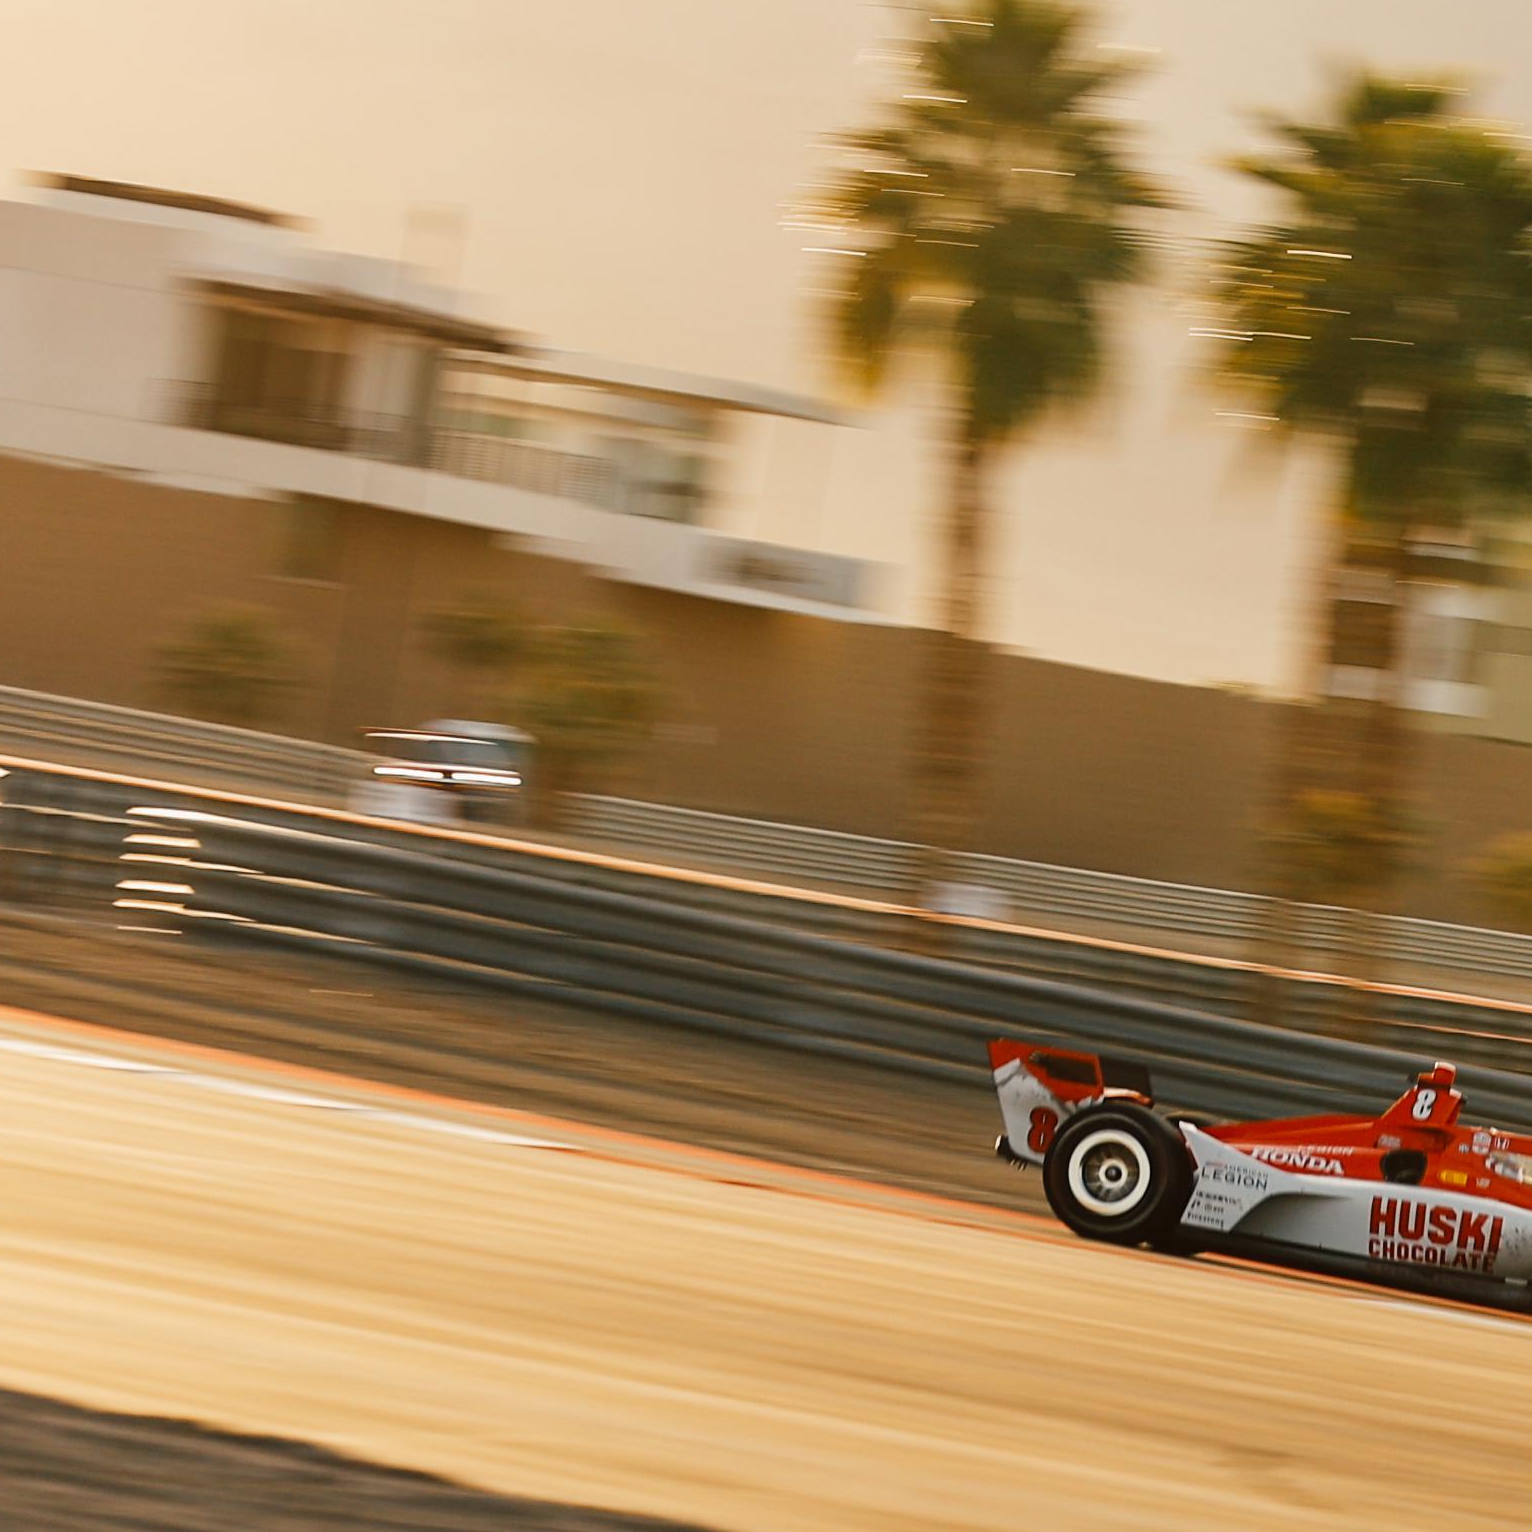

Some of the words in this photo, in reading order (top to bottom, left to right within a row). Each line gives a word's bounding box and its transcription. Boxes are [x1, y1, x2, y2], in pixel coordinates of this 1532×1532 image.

[1411, 1088, 1437, 1122] 8
[1027, 1106, 1059, 1153] 8
[1201, 1166, 1268, 1191] LEGION
[1251, 1147, 1345, 1176] HONDA
[1369, 1195, 1504, 1255] HUSKI
[1368, 1237, 1496, 1274] CHOCOLATE
